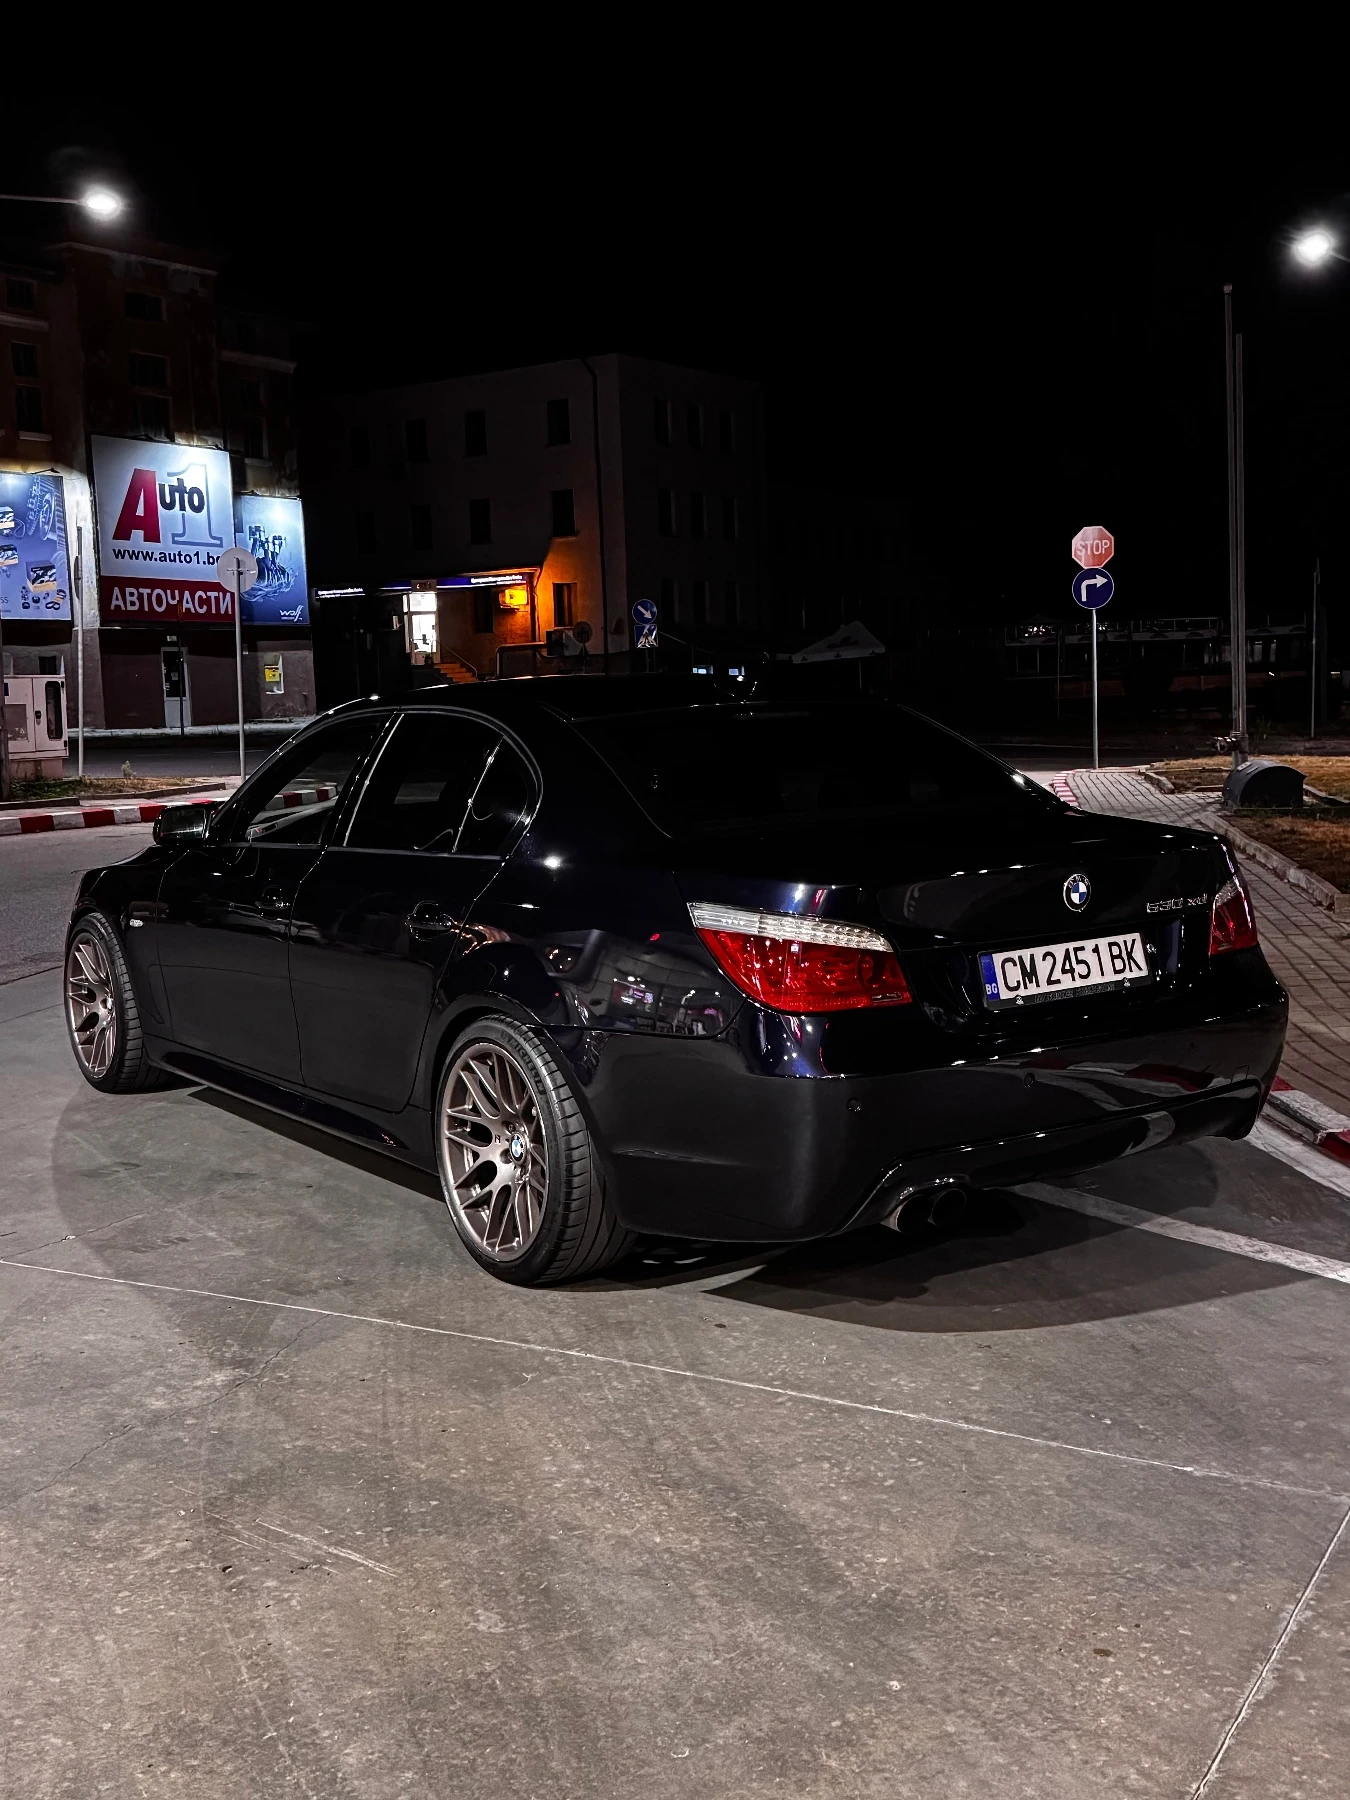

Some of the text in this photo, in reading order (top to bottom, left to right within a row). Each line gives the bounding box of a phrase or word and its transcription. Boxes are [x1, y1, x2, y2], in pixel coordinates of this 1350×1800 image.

[112, 468, 205, 543] Auto
[1076, 540, 1110, 555] STOP
[985, 983, 998, 995] BG
